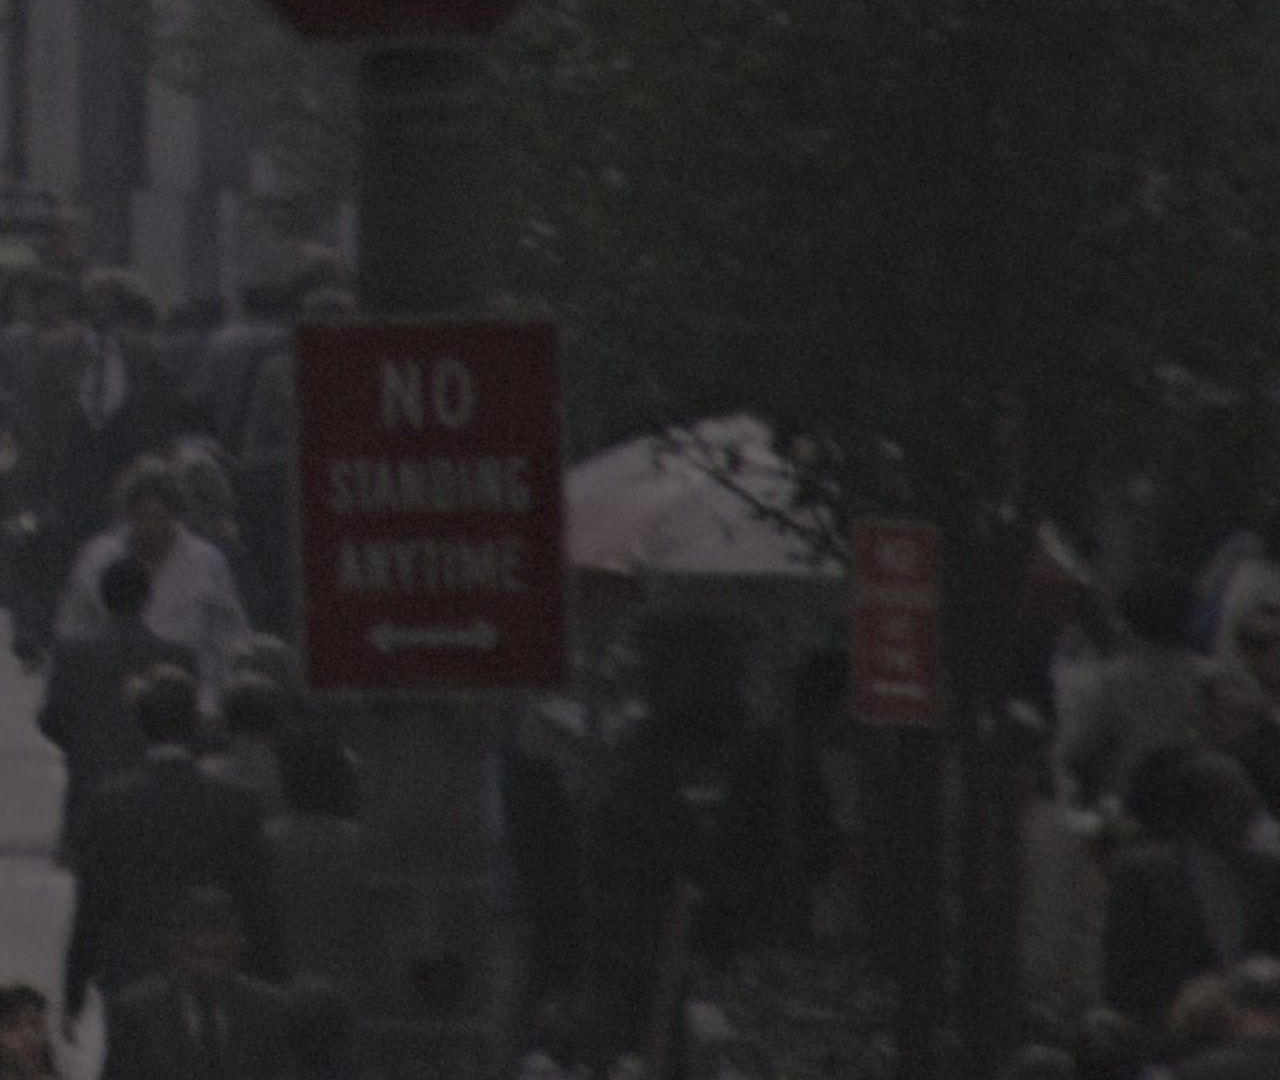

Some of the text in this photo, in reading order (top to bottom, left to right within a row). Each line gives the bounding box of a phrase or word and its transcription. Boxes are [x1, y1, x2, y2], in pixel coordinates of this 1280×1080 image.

[378, 357, 476, 431] NO
[328, 453, 532, 514] STANDING
[338, 535, 528, 596] ANYTIME
